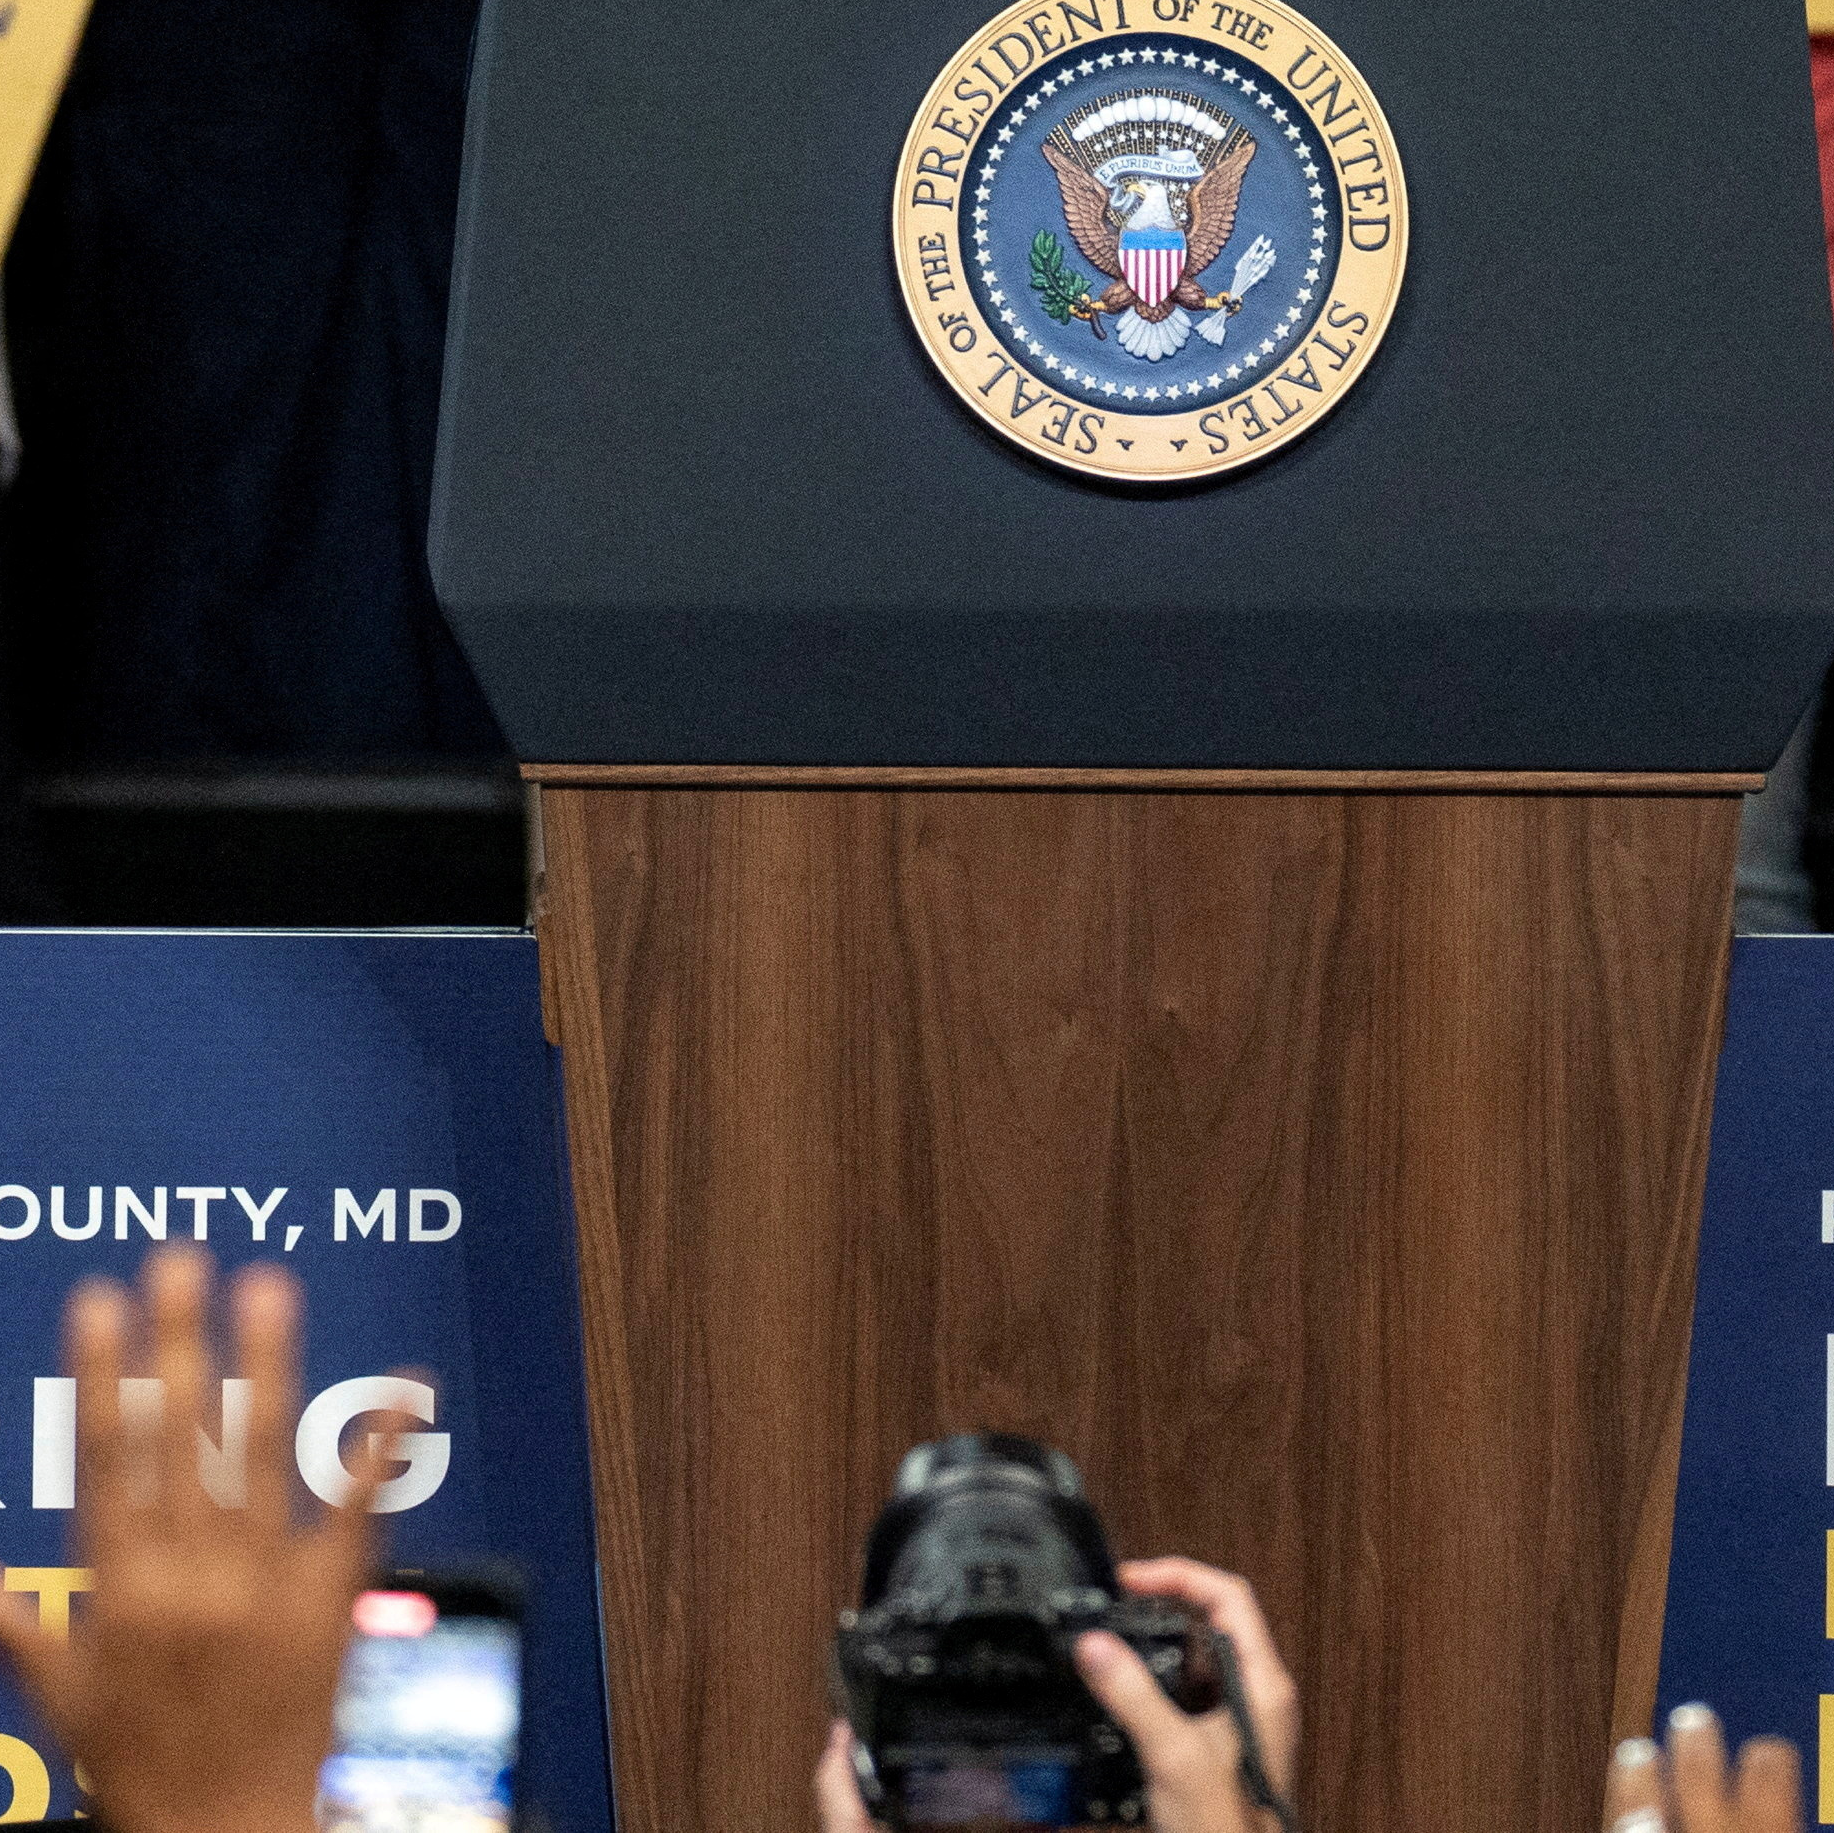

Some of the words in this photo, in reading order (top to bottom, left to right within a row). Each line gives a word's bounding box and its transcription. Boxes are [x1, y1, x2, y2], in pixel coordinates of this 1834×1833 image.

[1210, 0, 1276, 52] THE
[1285, 44, 1392, 253] UNITED
[920, 230, 957, 302] THE
[940, 309, 979, 355] OF
[978, 349, 1107, 456] SEAL
[1198, 298, 1371, 457] STATES
[333, 1187, 463, 1243] MD
